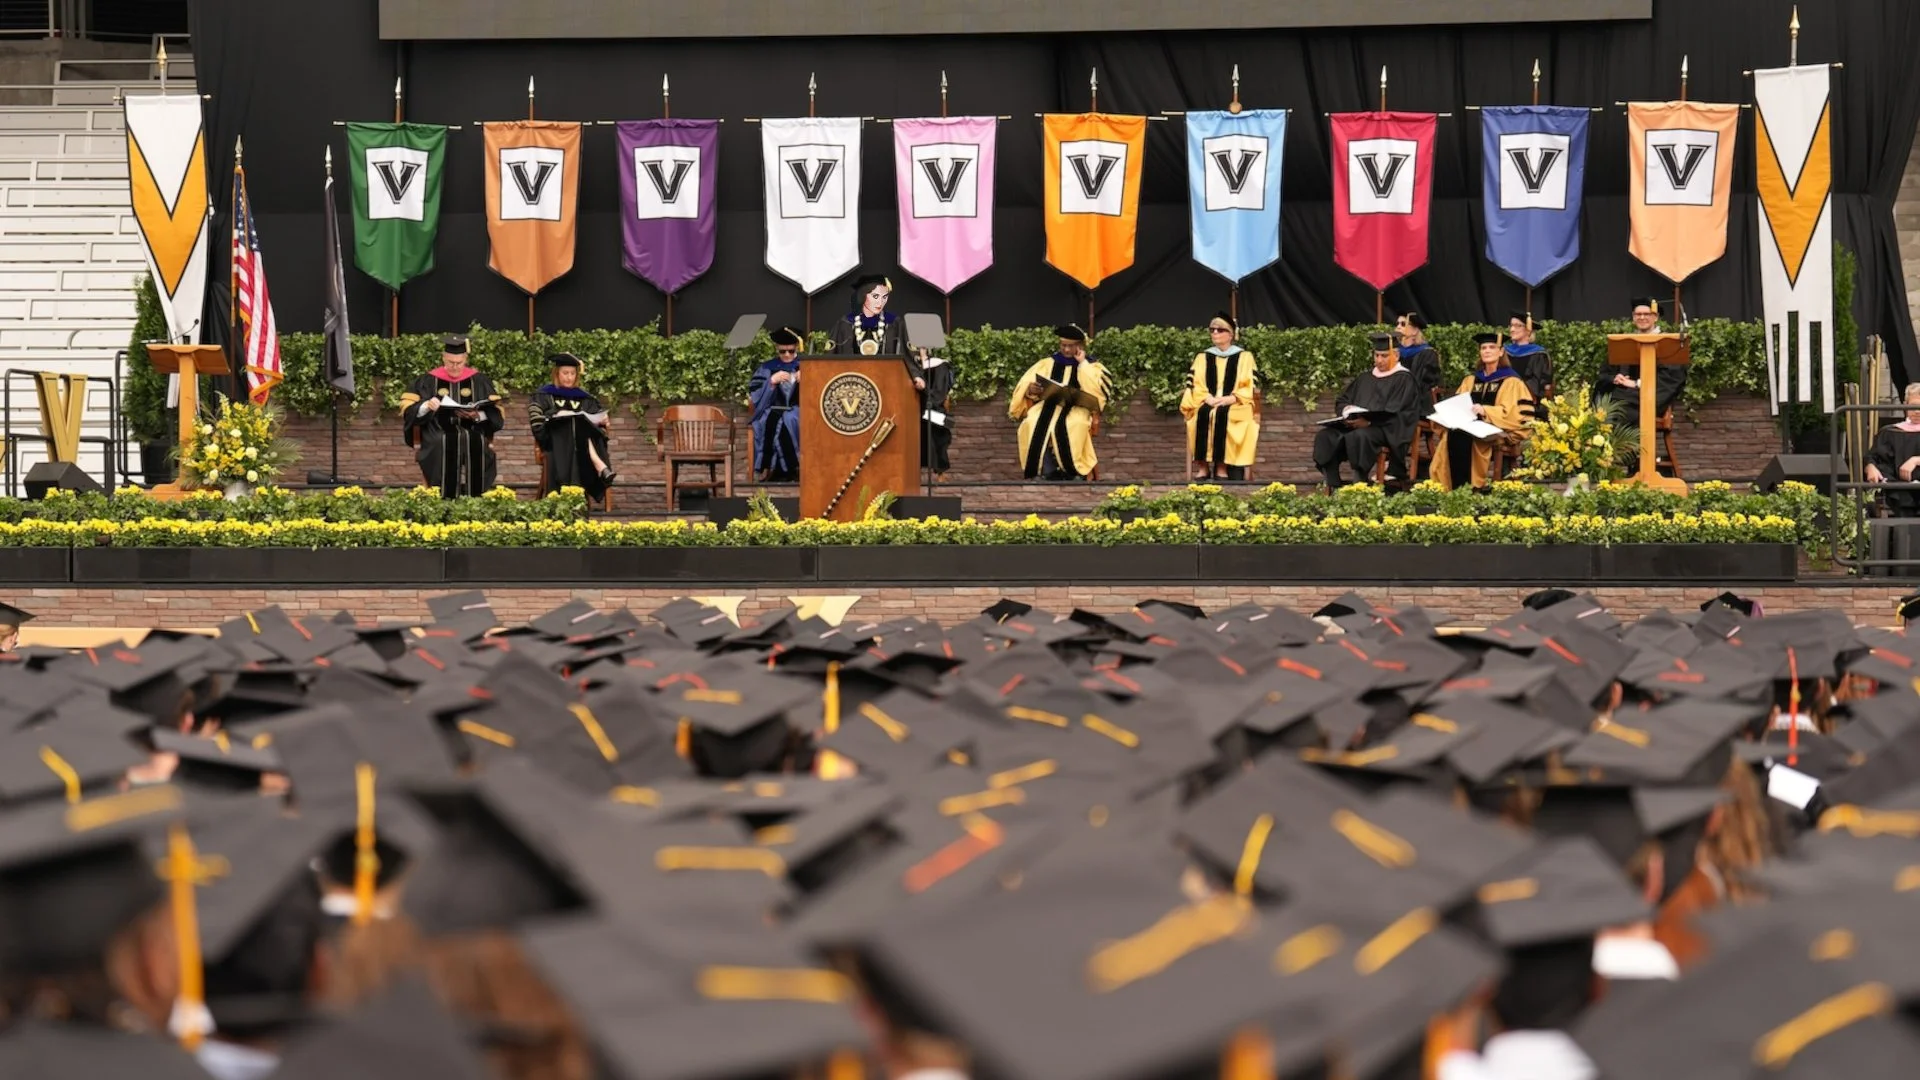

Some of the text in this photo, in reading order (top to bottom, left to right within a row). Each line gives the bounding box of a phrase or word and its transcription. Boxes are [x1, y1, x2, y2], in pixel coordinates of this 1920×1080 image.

[372, 160, 422, 205] V
[506, 161, 558, 206] V
[640, 159, 695, 204] V
[785, 158, 838, 204] V
[918, 157, 972, 204] V
[1066, 154, 1120, 199] V
[1210, 149, 1262, 195] V
[1354, 152, 1410, 199] V
[1506, 147, 1564, 192] V
[1650, 143, 1711, 190] V
[830, 376, 872, 390] VANDERBILT
[830, 417, 871, 431] UNIVERSITY
[841, 397, 861, 415] V
